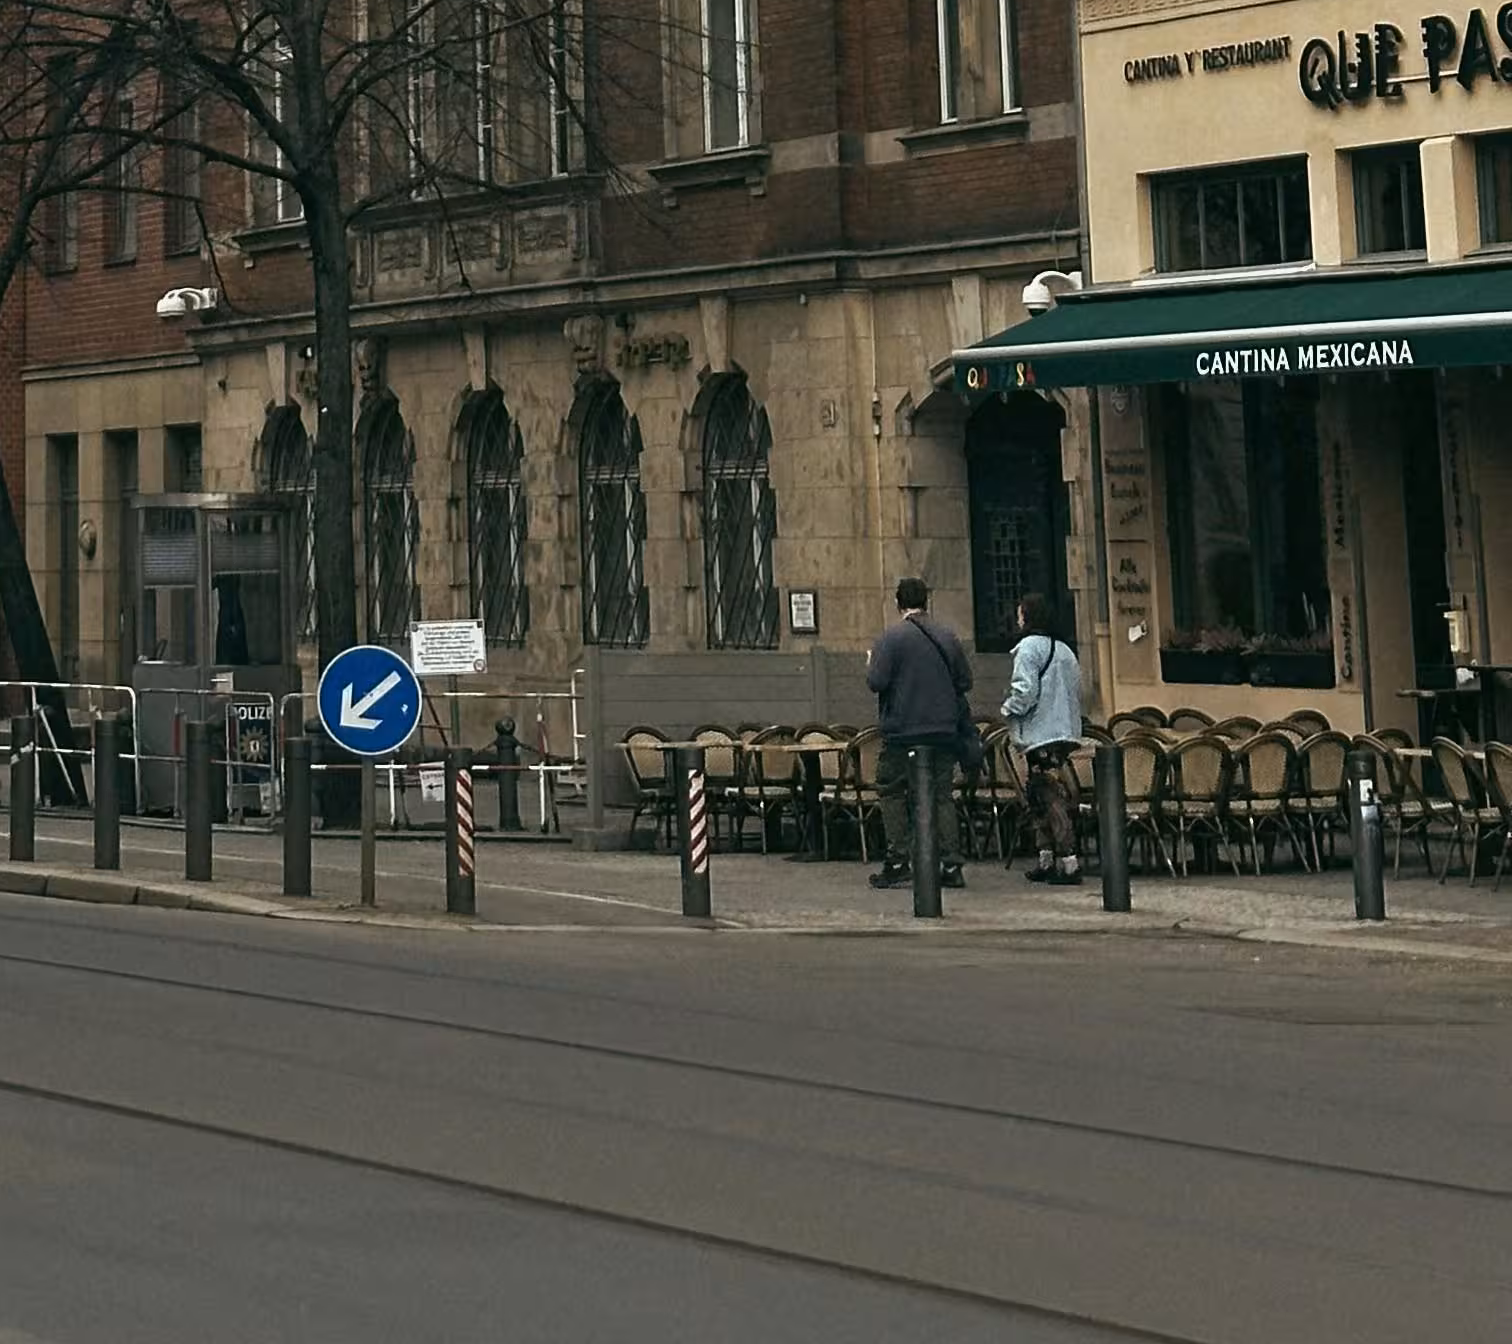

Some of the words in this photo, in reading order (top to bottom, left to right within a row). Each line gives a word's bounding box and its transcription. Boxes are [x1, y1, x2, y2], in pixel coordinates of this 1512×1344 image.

[1124, 54, 1182, 84] CANTINA
[1184, 51, 1195, 74] Y
[1202, 36, 1292, 73] RESTAURANT
[1196, 346, 1290, 376] CANTINA
[1297, 339, 1414, 370] MEXICANA
